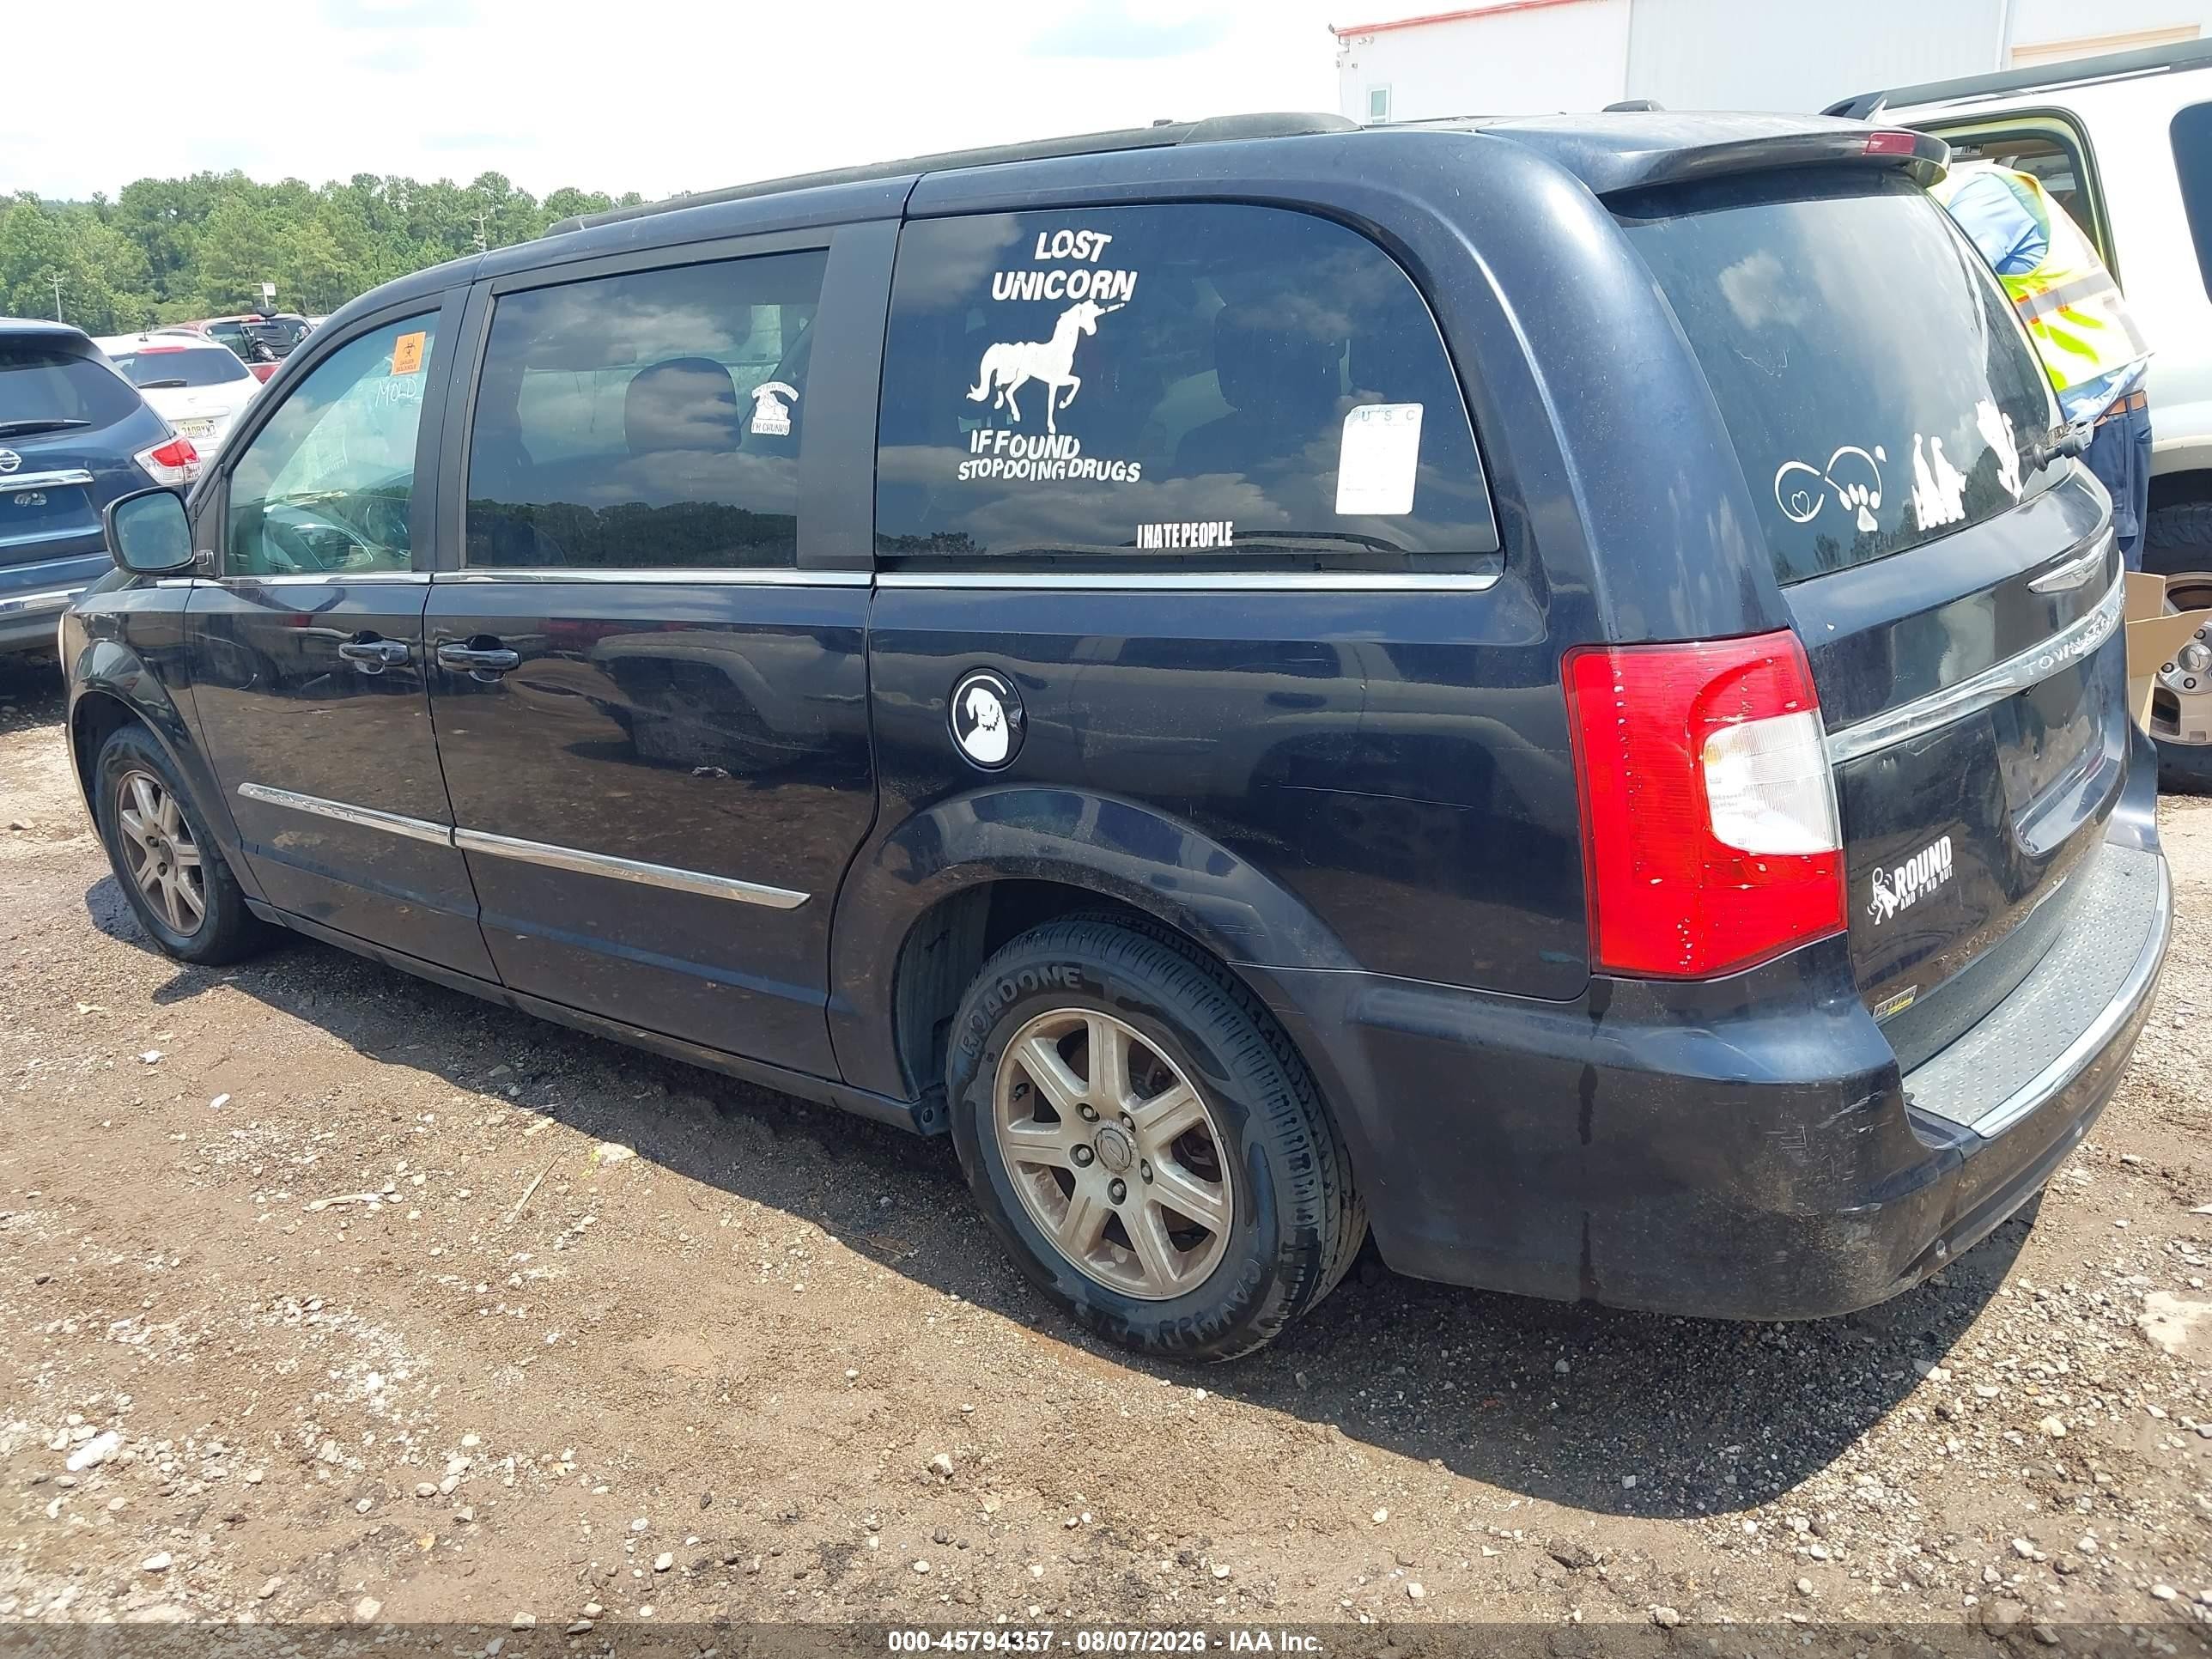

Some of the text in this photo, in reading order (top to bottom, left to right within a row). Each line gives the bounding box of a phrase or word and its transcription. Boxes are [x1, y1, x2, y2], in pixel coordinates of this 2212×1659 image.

[1034, 229, 1112, 262] LOST
[992, 269, 1138, 301] UNICORN
[970, 429, 1080, 460] IF FOUND
[957, 457, 1141, 483] STOP DOING DRUGS
[1181, 521, 1233, 548] PEOPLE
[1900, 890, 1916, 911] AND
[1939, 864, 1953, 884] OUT
[957, 965, 1082, 1058] ROADONE
